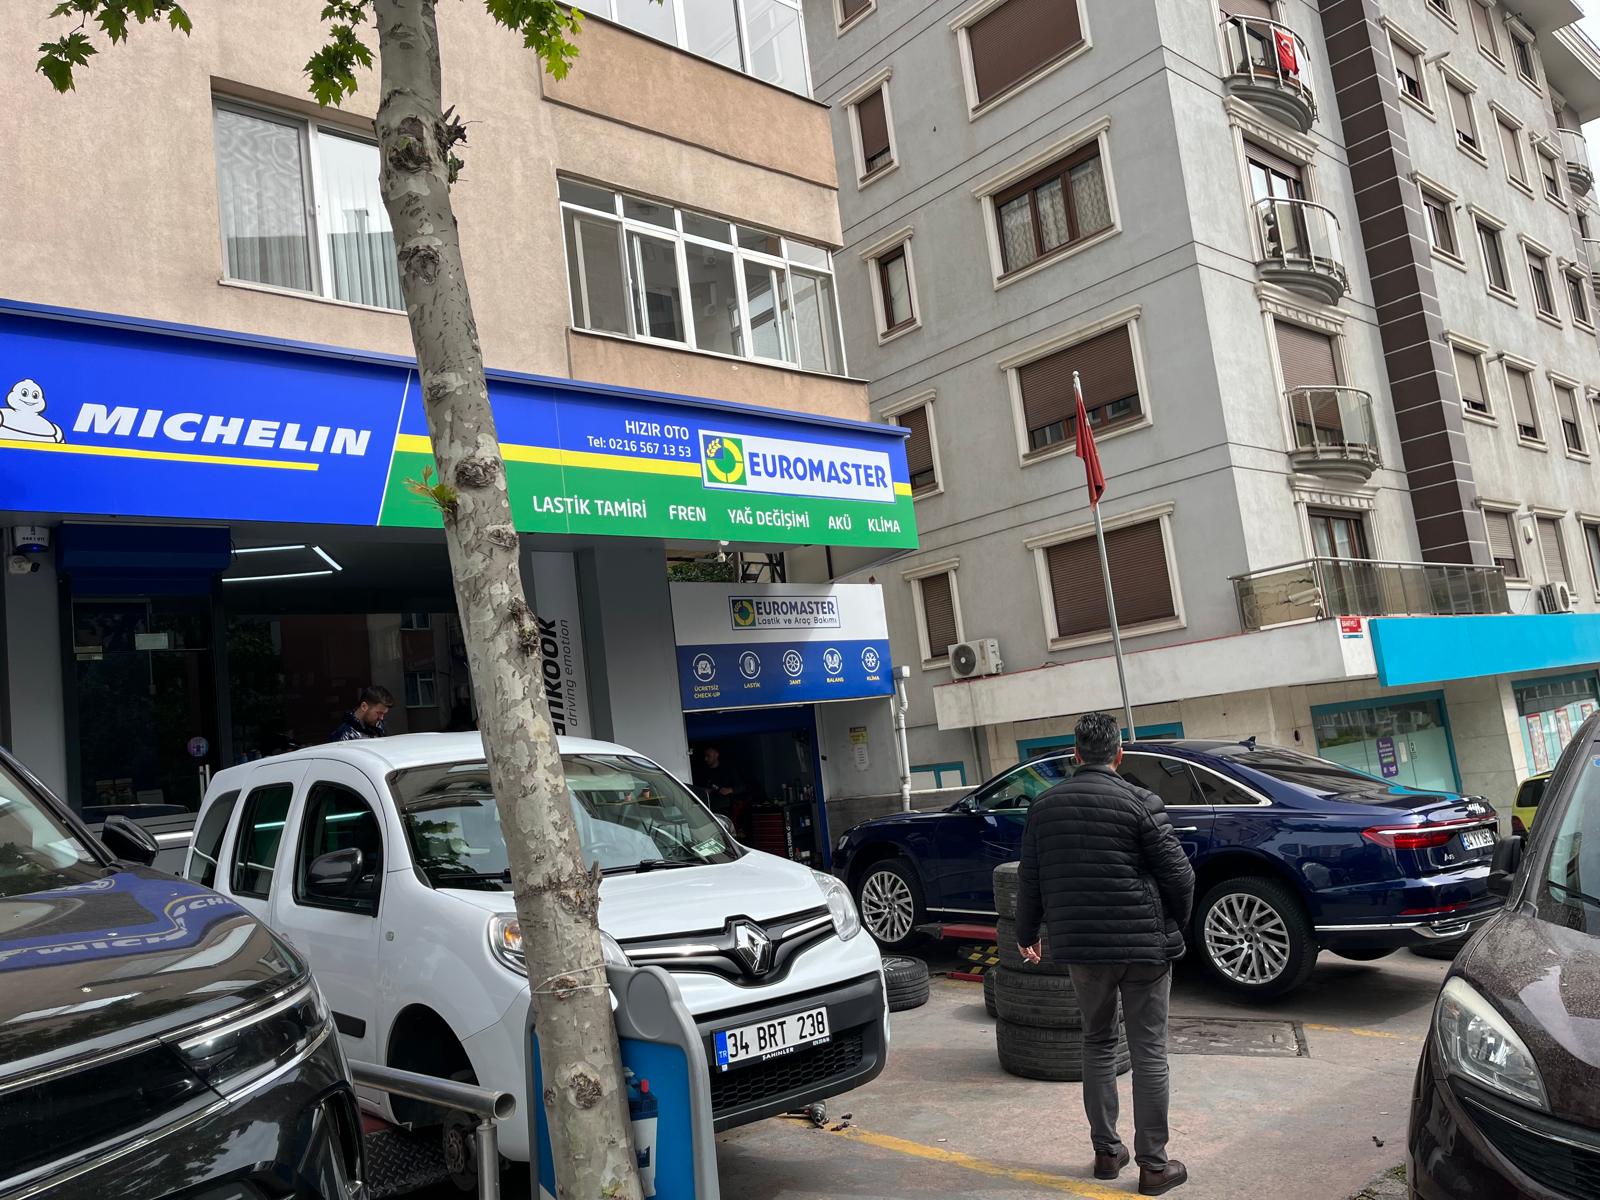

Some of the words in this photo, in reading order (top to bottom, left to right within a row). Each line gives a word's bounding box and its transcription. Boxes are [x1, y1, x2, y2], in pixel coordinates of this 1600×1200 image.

[72, 403, 371, 456] MICHELIN
[625, 420, 661, 437] HIZIR
[664, 425, 689, 440] OTO
[587, 436, 606, 449] Tel:
[609, 438, 636, 452] 0216
[640, 441, 659, 455] 567
[663, 444, 675, 456] 13
[679, 445, 692, 458] 53
[749, 451, 888, 488] EUROMASTER
[532, 494, 591, 515] LASTİK
[594, 498, 647, 518] TAMİRİ
[668, 505, 707, 522] FREN
[727, 507, 753, 525] YAĞ
[756, 508, 810, 531] DEĞİŞİMİ
[828, 513, 852, 530] AKÜ
[867, 516, 900, 533] KLİMA
[756, 600, 836, 615] EUROMASTER
[757, 616, 780, 625] Lastik
[794, 617, 810, 626] Araç
[560, 619, 572, 675] emotion
[565, 677, 578, 726] driving
[693, 691, 721, 699] CHECK-UP
[727, 1031, 750, 1058] 34
[756, 1021, 786, 1051] BRT
[797, 1011, 826, 1040] 238
[719, 1050, 728, 1059] TR
